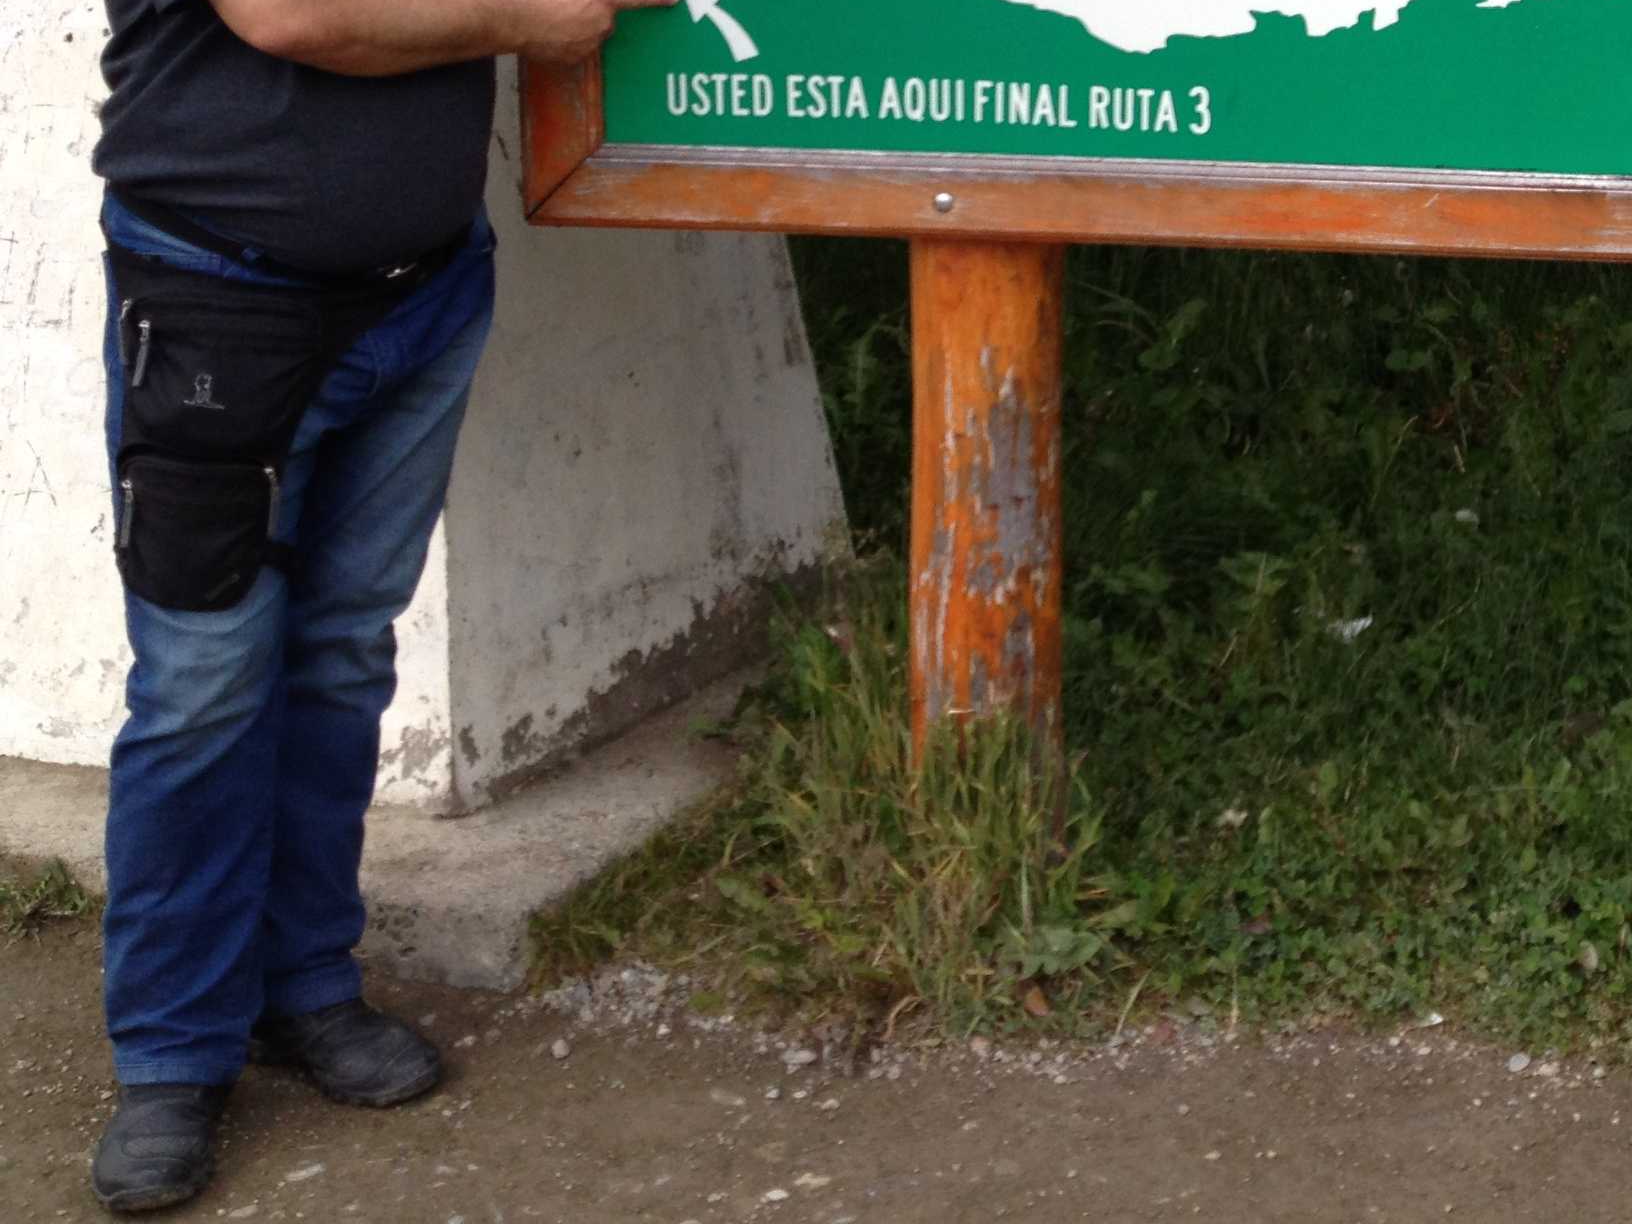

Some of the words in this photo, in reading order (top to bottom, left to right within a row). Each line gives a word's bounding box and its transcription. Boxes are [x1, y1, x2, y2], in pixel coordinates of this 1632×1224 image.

[665, 72, 774, 118] USTED
[785, 74, 869, 119] ESTA
[878, 76, 966, 122] AQUI
[972, 79, 1078, 128] FINAL
[1088, 85, 1178, 133] RUTA
[1188, 85, 1212, 135] 3
